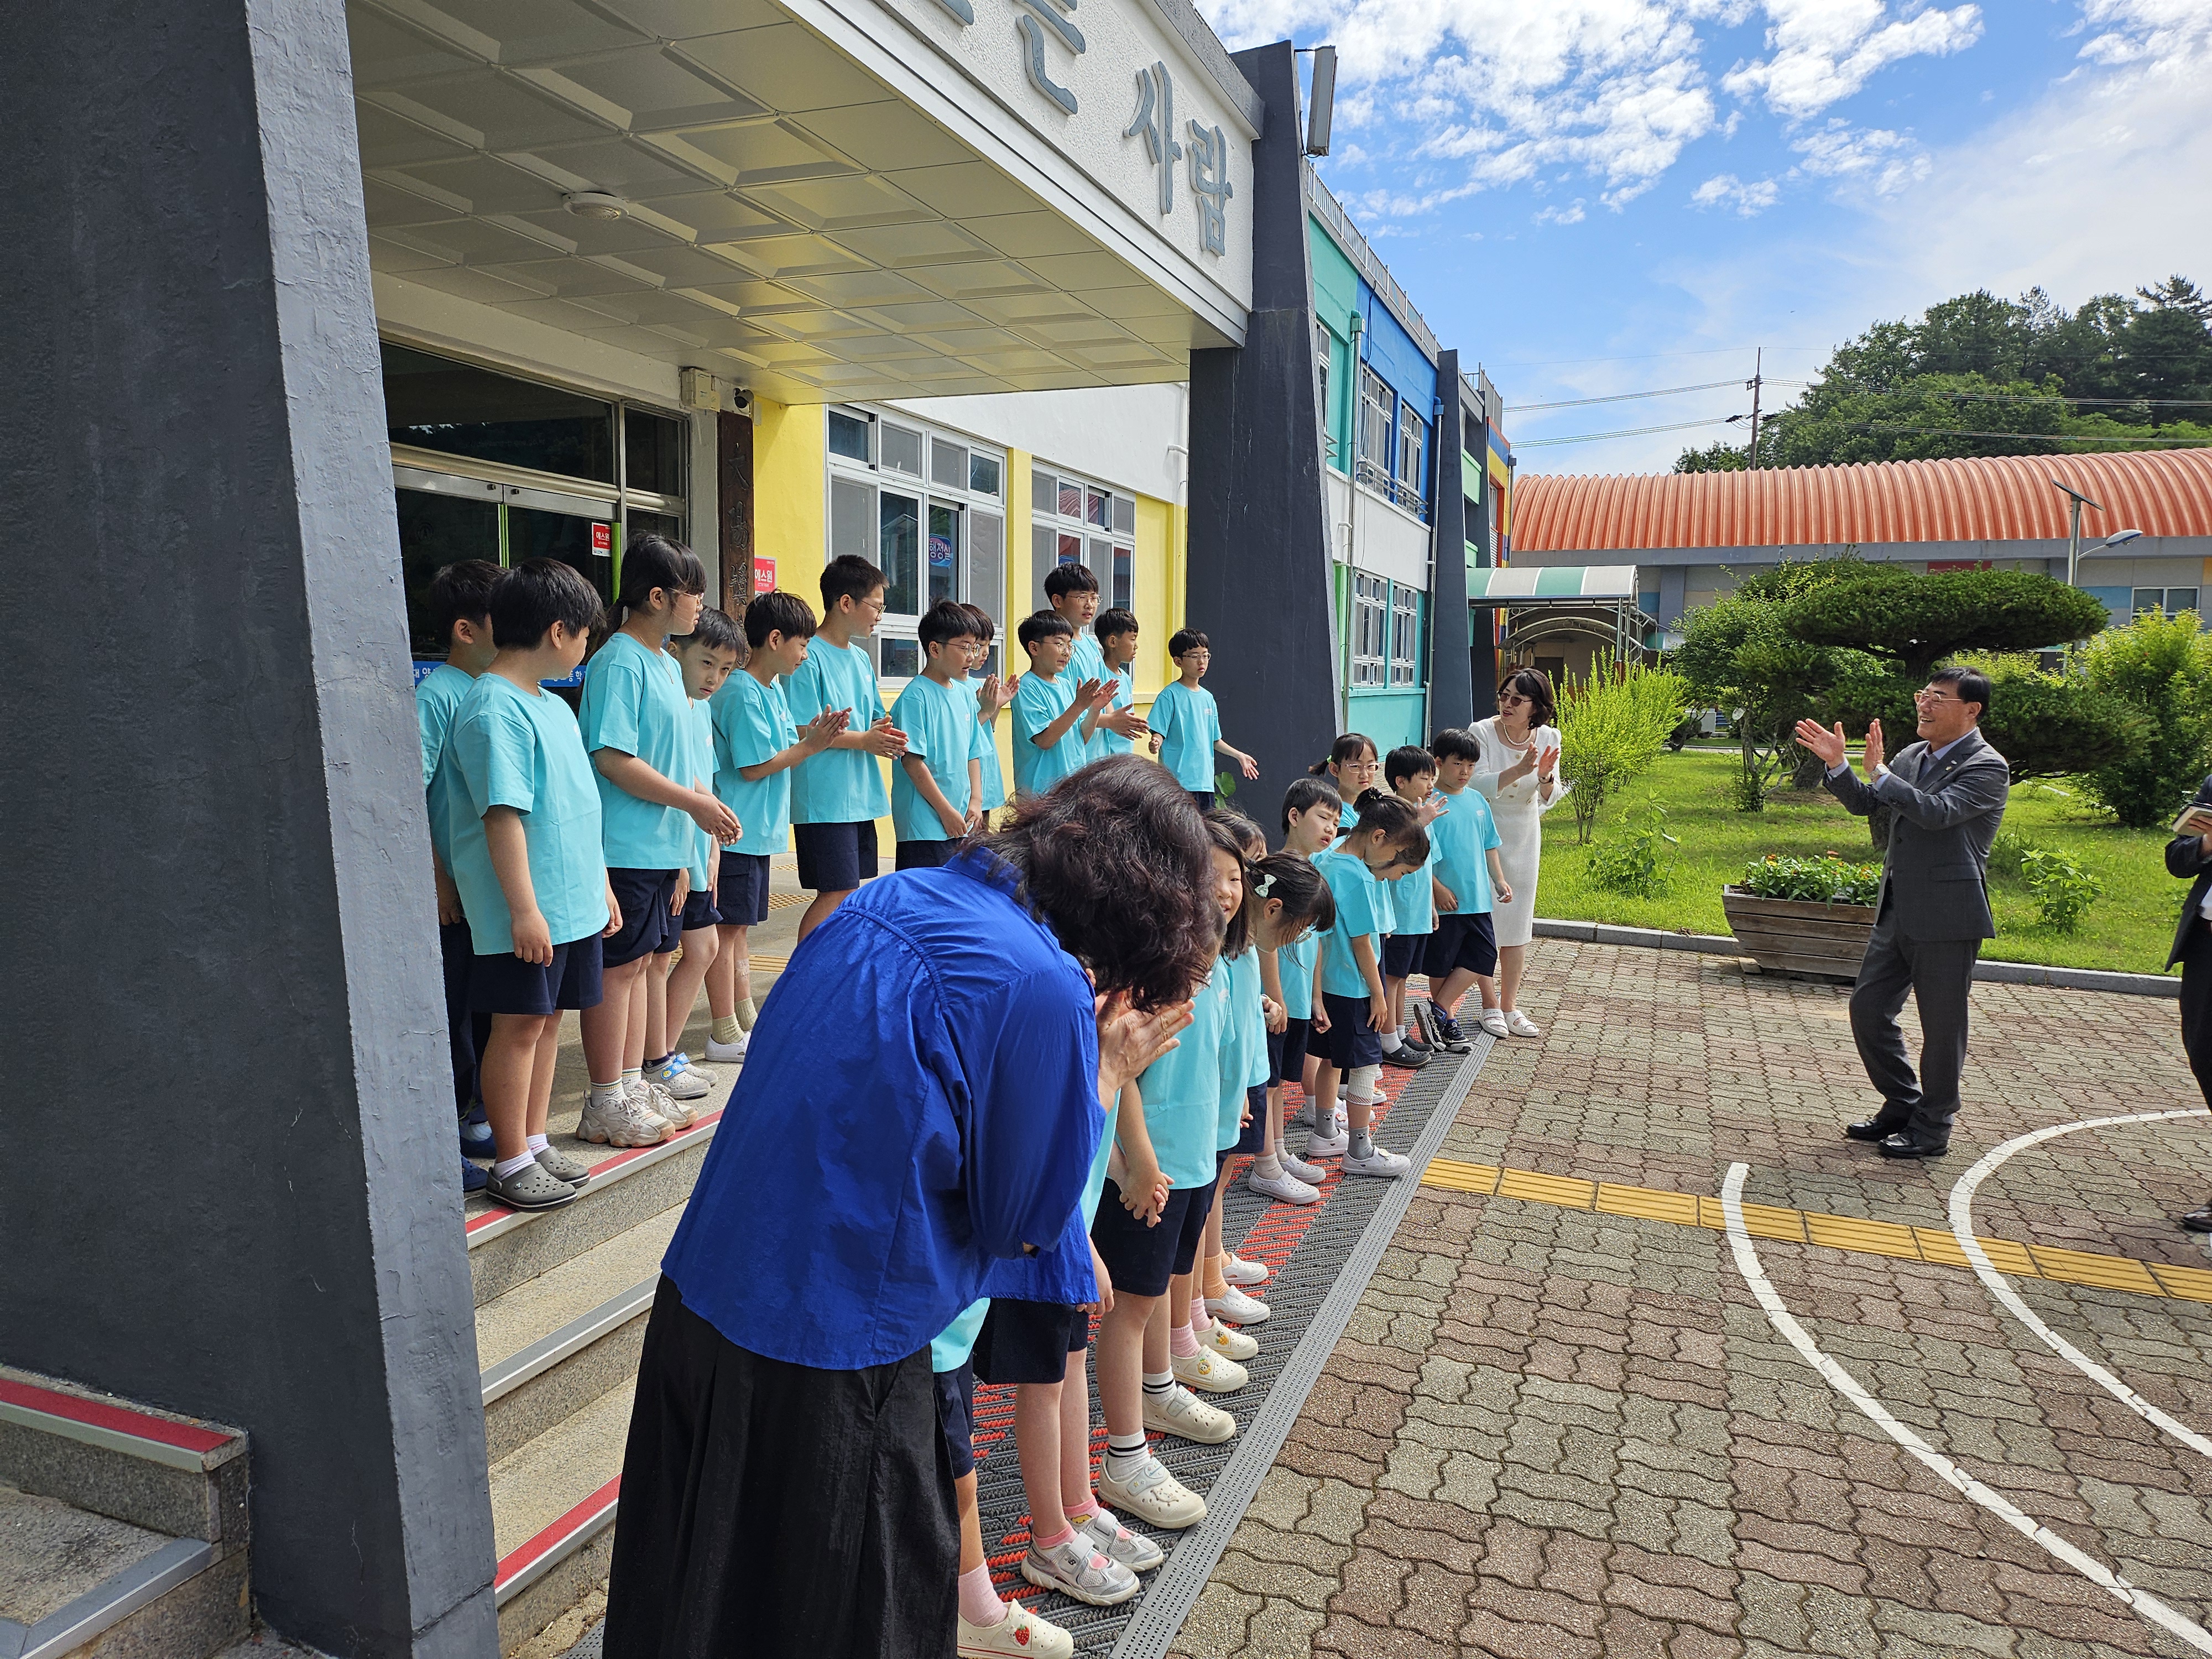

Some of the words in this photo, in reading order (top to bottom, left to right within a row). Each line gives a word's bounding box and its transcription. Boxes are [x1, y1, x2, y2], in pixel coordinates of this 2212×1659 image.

[1123, 60, 1233, 257] 사람
[596, 531, 610, 541] 에스원
[929, 540, 951, 561] 행정실
[754, 568, 773, 583] 에스원
